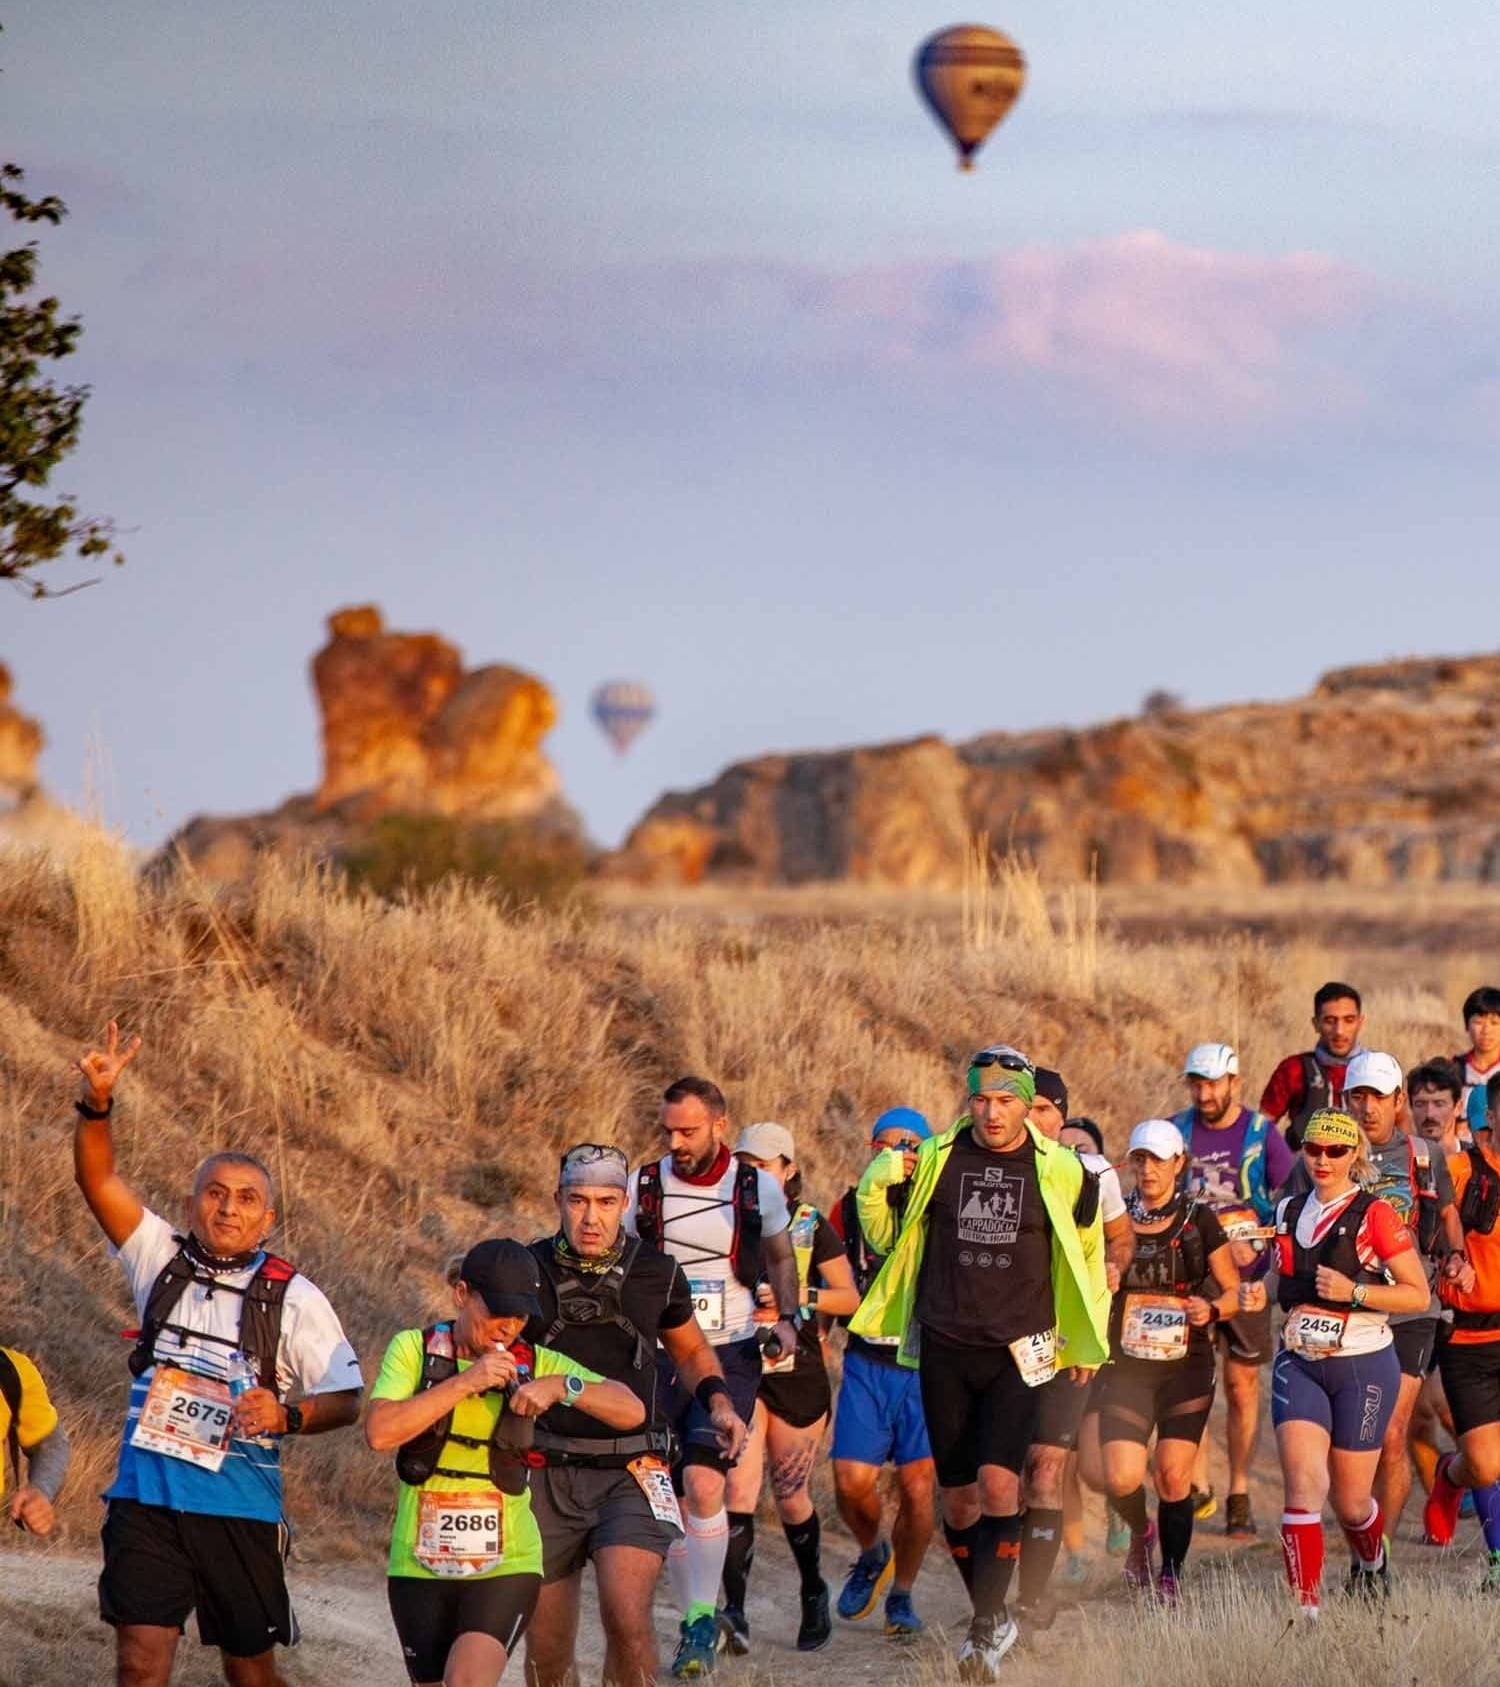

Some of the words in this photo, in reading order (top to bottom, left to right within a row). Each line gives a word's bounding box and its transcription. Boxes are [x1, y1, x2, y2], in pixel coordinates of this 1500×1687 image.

[961, 1219, 1014, 1233] CAPPADOCIA
[1143, 1312, 1184, 1327] 2434
[1301, 1318, 1340, 1334] 2454
[171, 1397, 228, 1426] 2675
[440, 1514, 497, 1531] 2686
